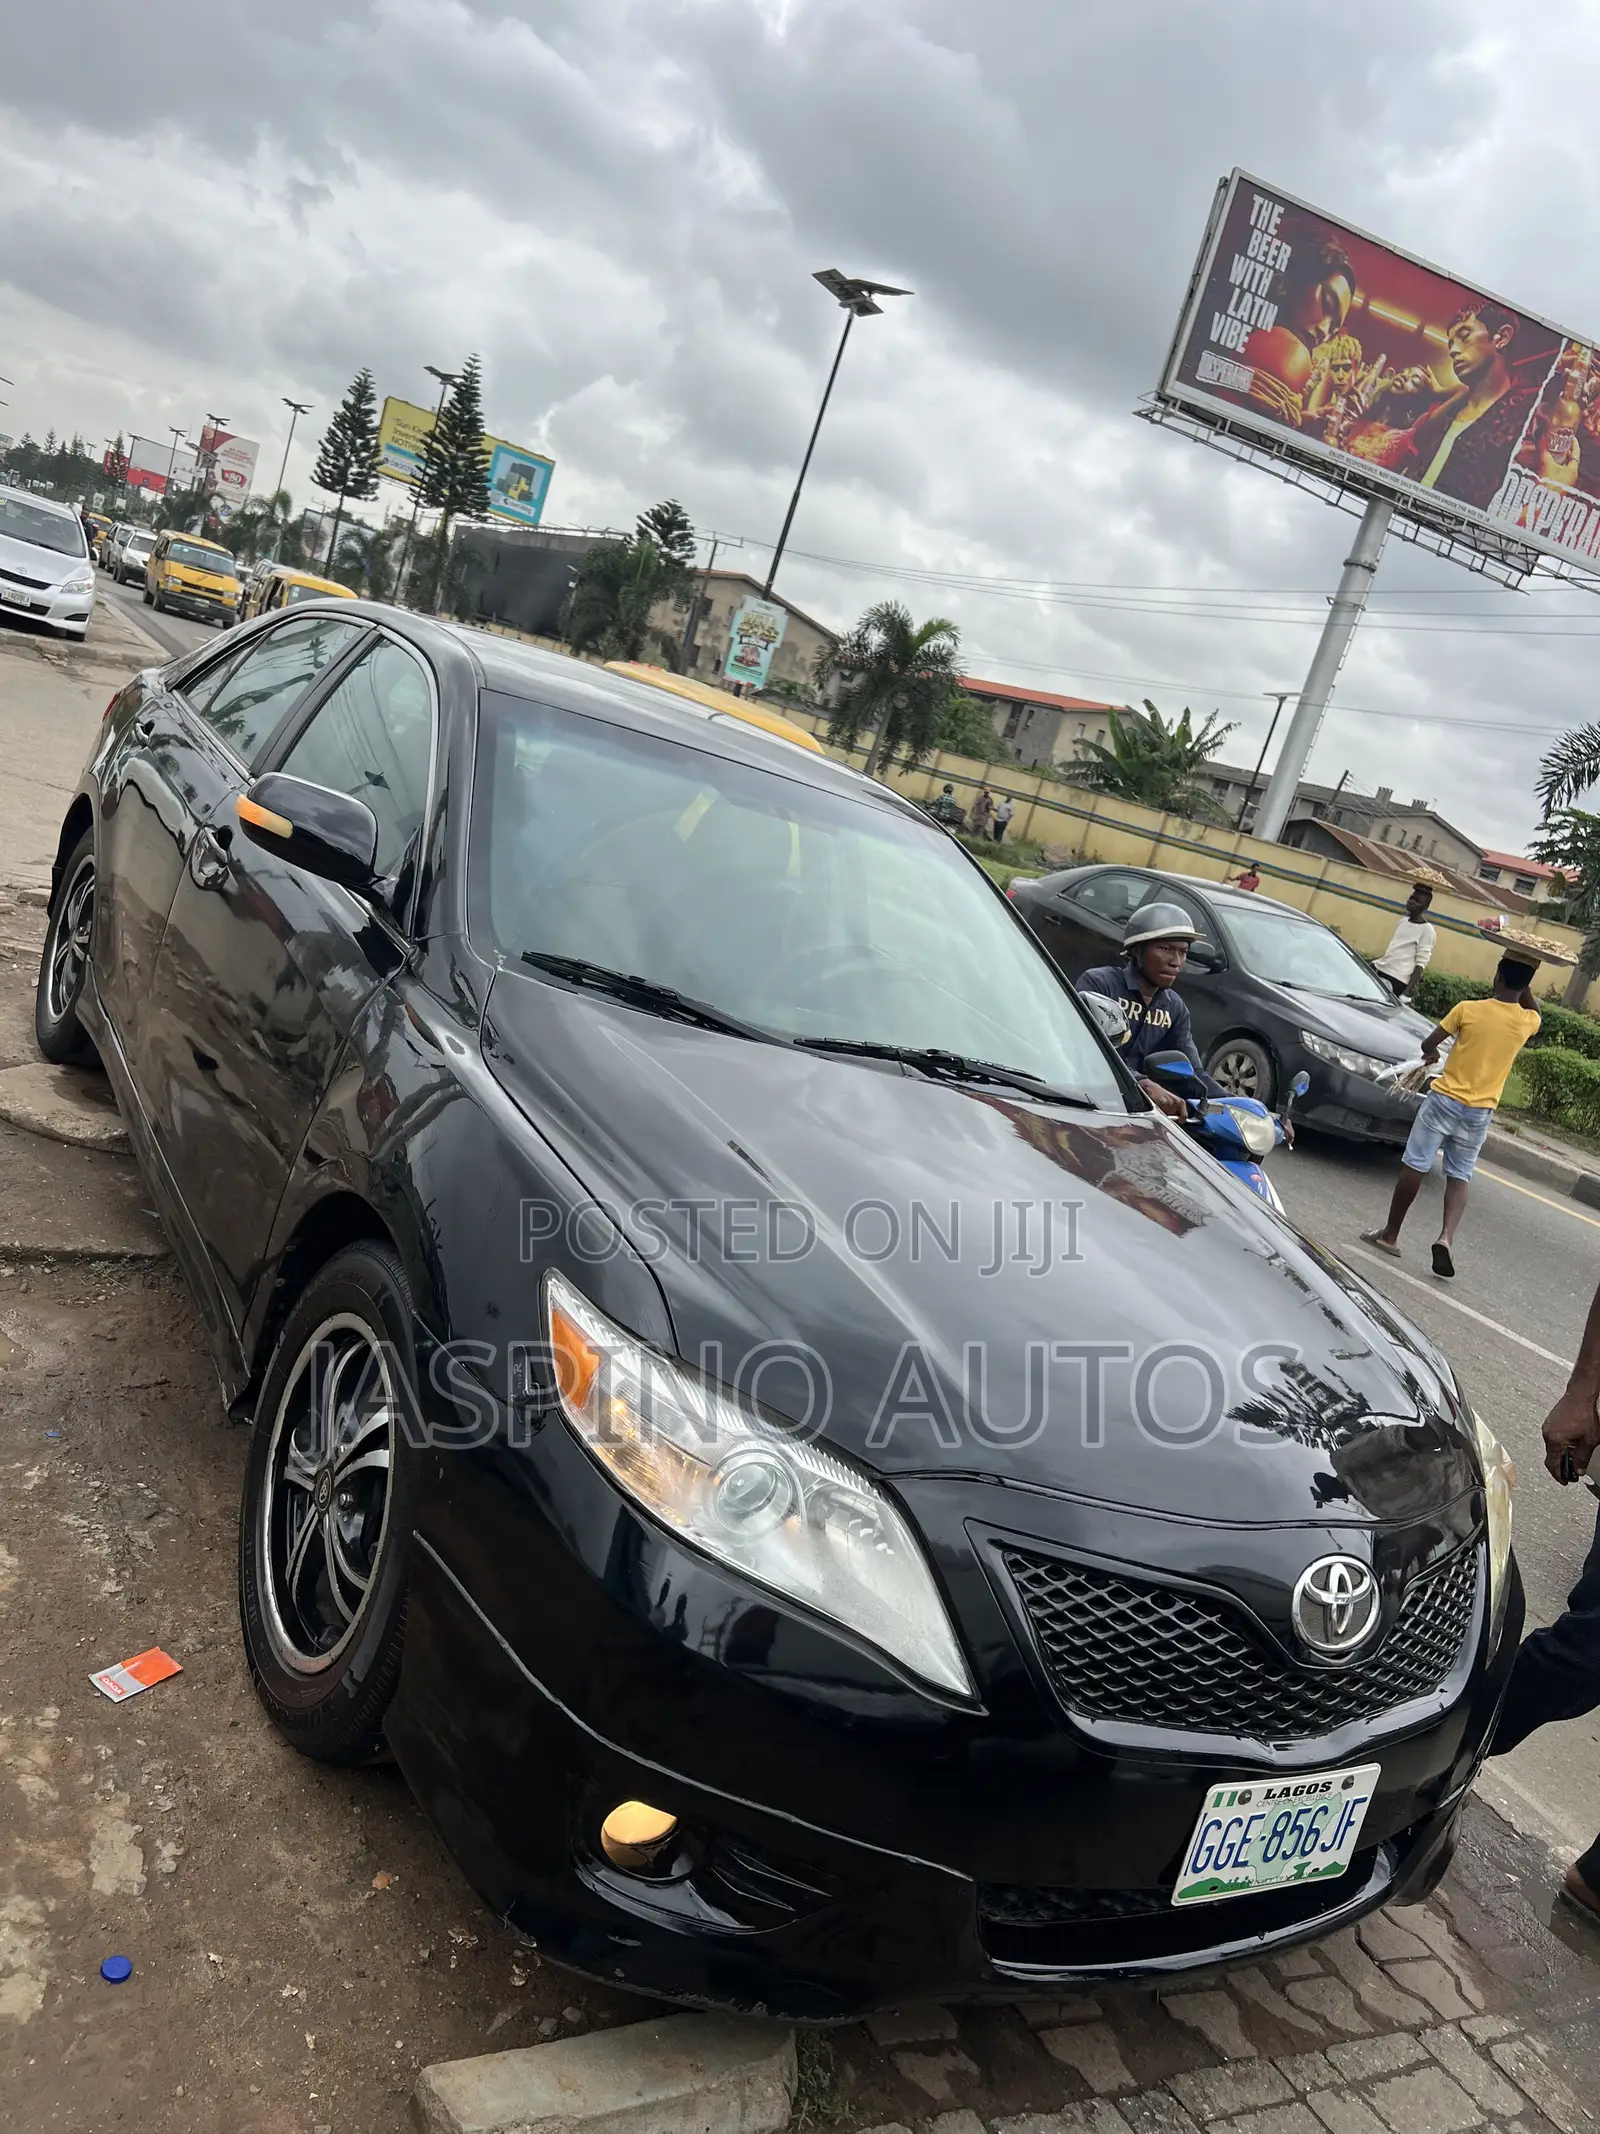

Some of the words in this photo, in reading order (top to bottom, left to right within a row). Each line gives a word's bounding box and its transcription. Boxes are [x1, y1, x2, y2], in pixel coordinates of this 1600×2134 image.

[1249, 193, 1285, 236] THE
[1247, 228, 1292, 273] BEER
[1228, 252, 1274, 298] WITH
[1227, 286, 1278, 333] LATIN
[1209, 311, 1252, 354] VIBE
[1118, 997, 1172, 1029] PRADA
[1256, 1797, 1282, 1808] CENTRE
[1294, 1791, 1334, 1803] EXCELLENCE
[1263, 1781, 1333, 1800] LAGOS
